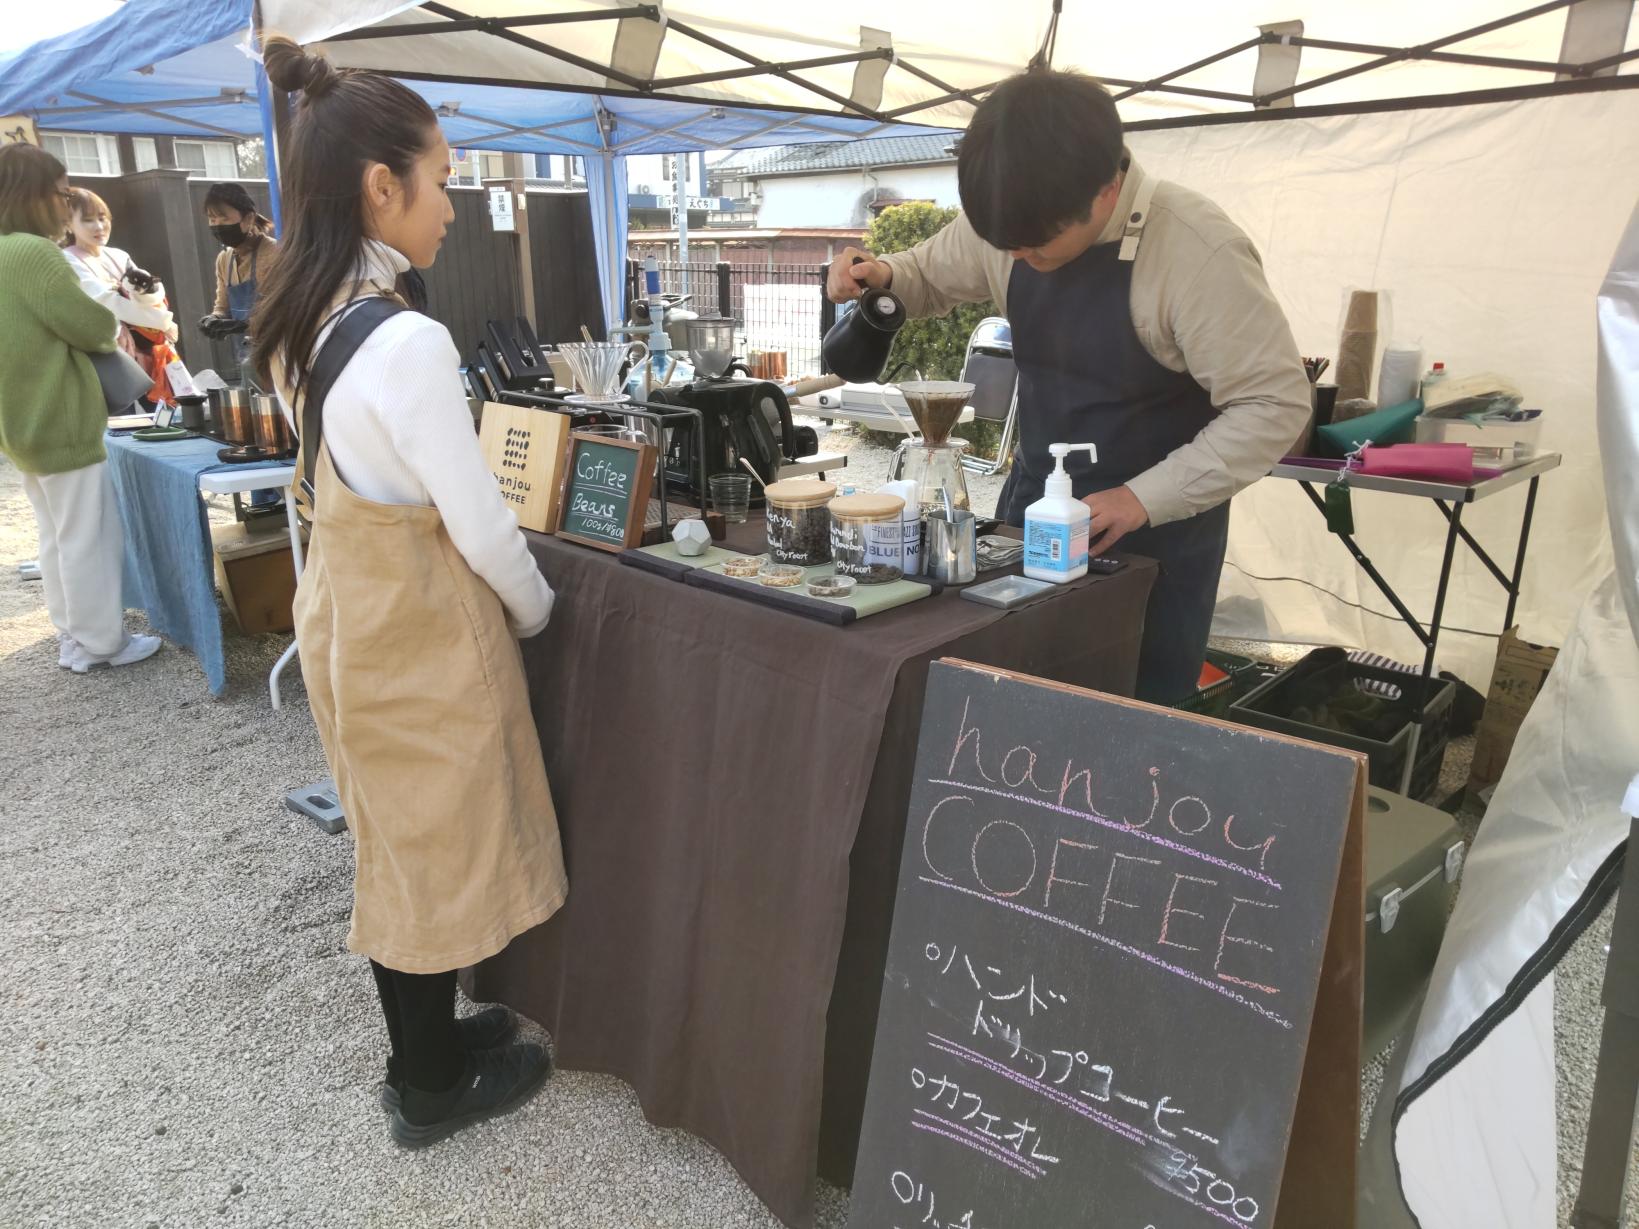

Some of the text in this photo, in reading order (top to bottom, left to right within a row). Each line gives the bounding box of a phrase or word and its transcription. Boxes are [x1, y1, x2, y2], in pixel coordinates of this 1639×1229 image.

[500, 490, 526, 504] OFFEE
[577, 452, 627, 489] Coffee
[571, 492, 616, 518] Beans
[869, 545, 900, 557] BLUE
[947, 695, 1276, 871] hanjou
[922, 795, 1281, 995] COFFEE
[972, 1000, 1219, 1145] ドリップコーヒー
[929, 1074, 1060, 1164] カフェオレ
